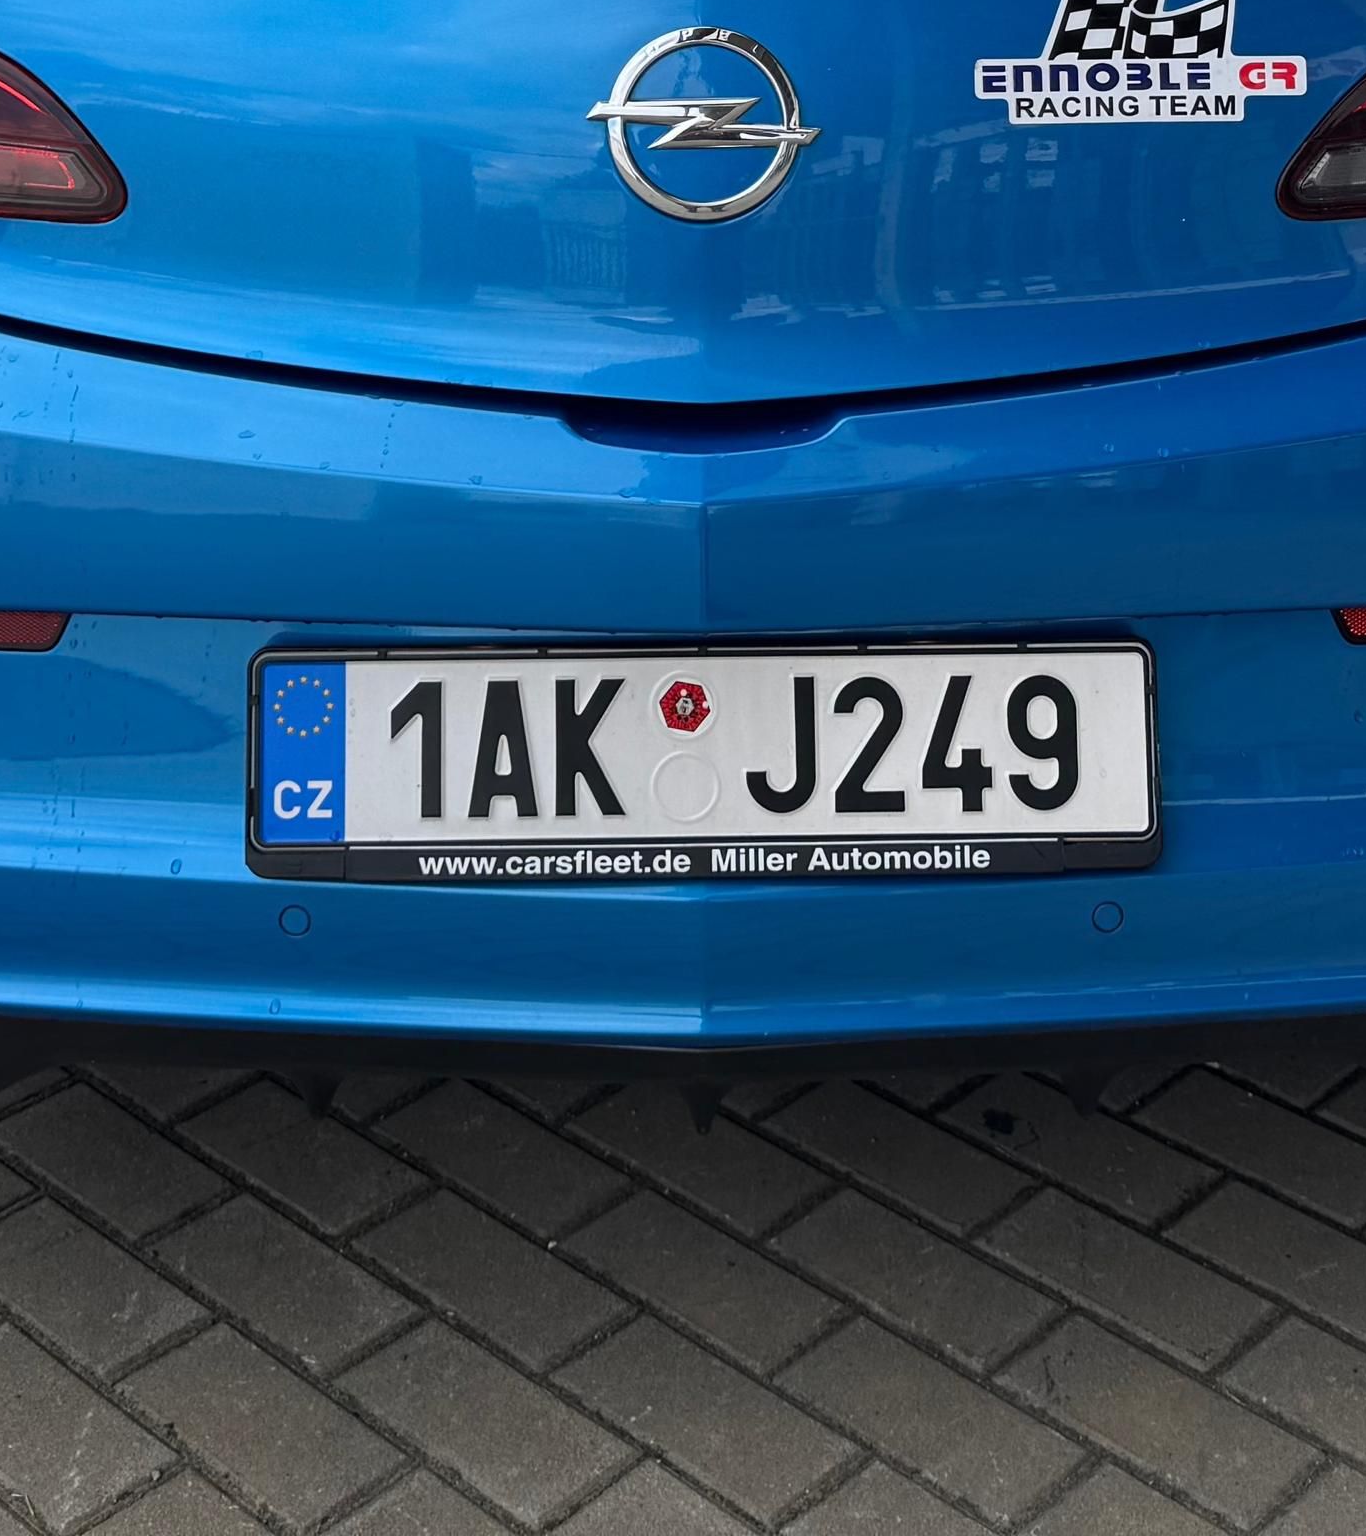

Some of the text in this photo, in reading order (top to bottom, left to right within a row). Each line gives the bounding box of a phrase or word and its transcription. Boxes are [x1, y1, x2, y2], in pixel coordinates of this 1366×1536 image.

[1238, 62, 1298, 90] GR
[1015, 94, 1236, 119] RACING TEAM
[390, 674, 1079, 819] 1AK J249
[273, 780, 333, 819] CZ
[418, 845, 991, 875] www.carsfleet.de Miller Automobile
